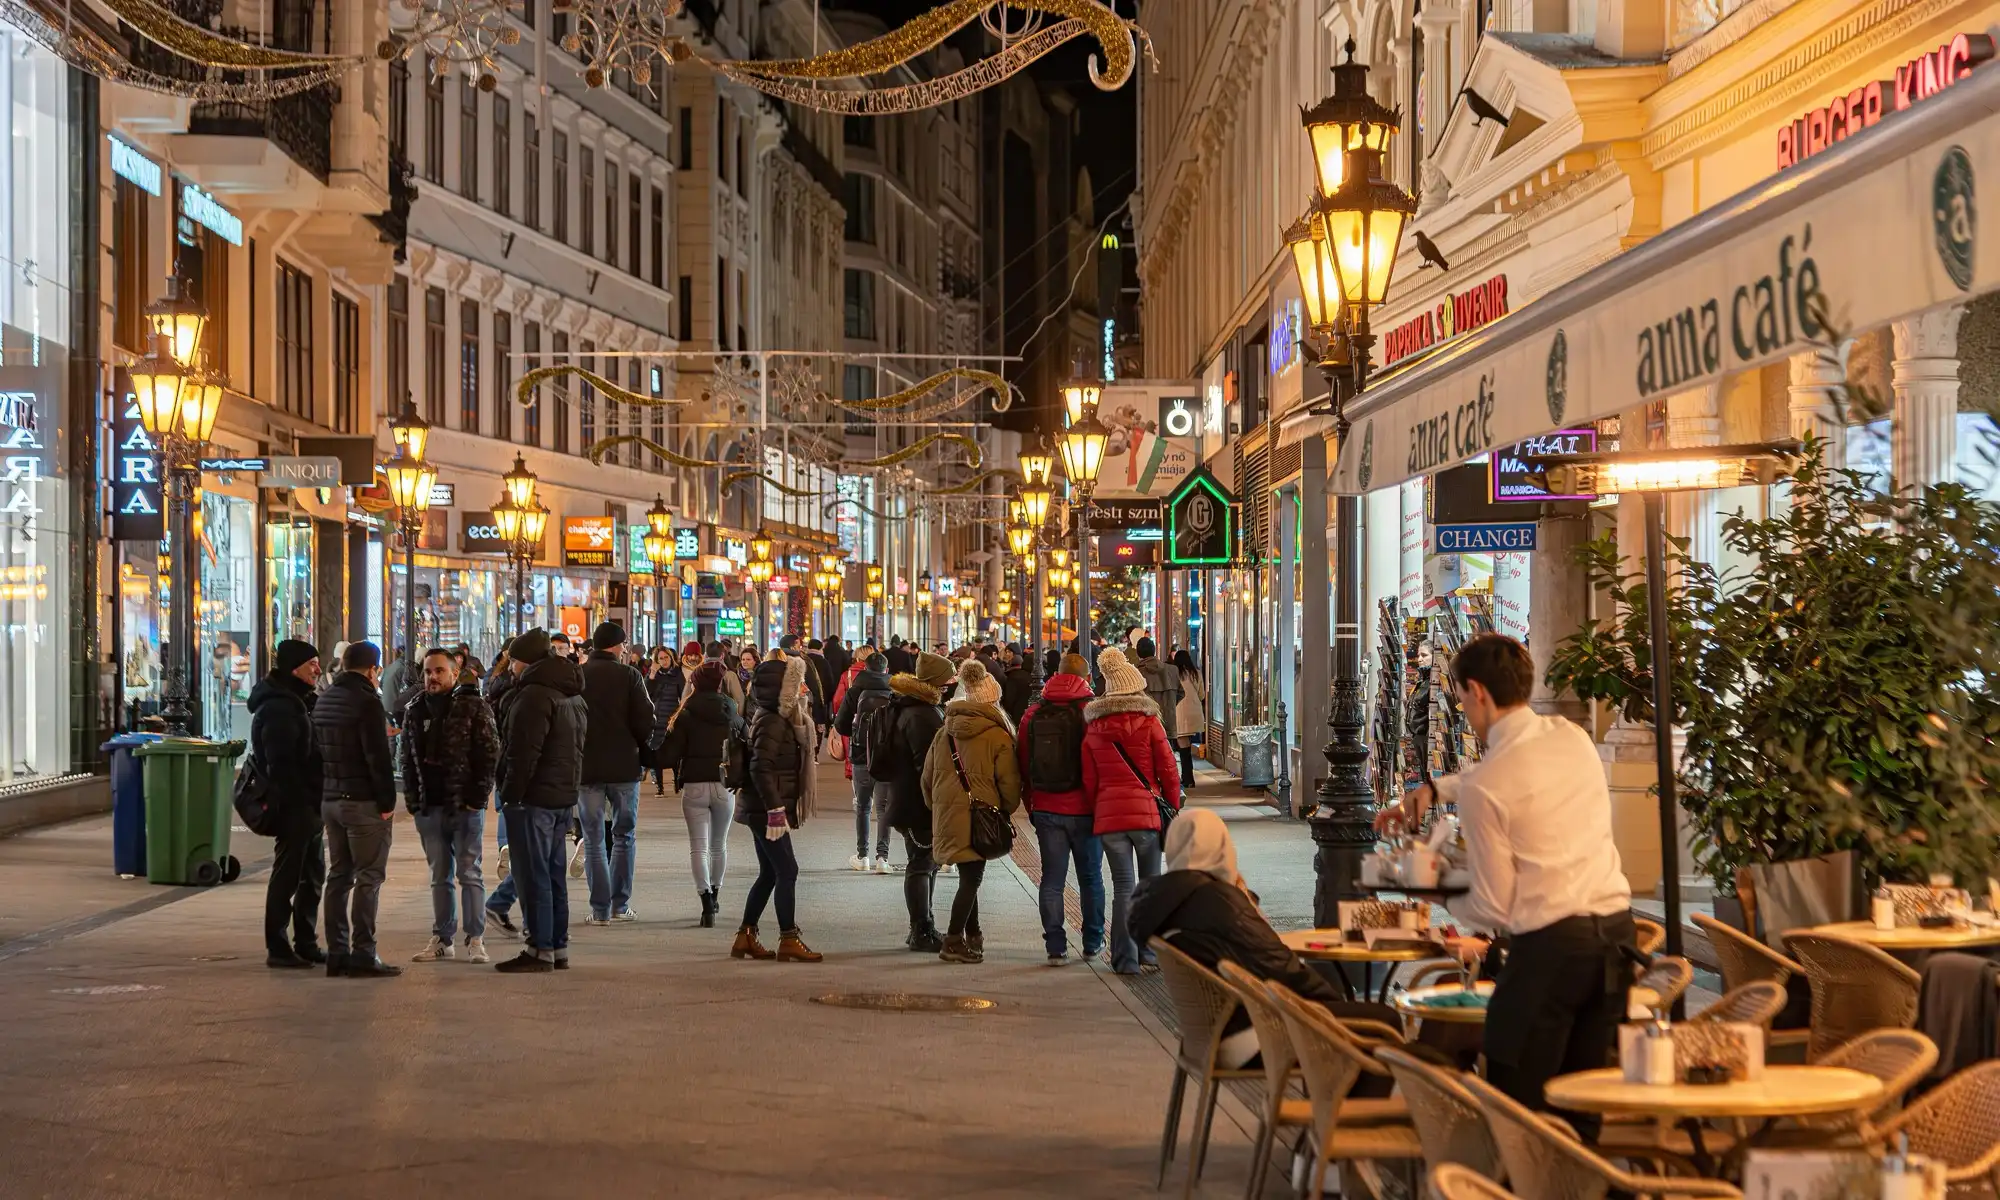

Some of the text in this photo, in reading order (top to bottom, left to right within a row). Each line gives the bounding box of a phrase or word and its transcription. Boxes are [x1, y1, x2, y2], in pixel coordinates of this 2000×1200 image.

[1778, 32, 1973, 172] BURGER KING
[1385, 311, 1435, 366] PAPRIKA
[1636, 222, 1823, 397] anna café
[121, 393, 157, 514] ZARA
[1407, 367, 1496, 475] anna café
[261, 464, 336, 481] LINIQUE
[468, 525, 501, 539] ecc
[1439, 528, 1533, 549] CHANGE
